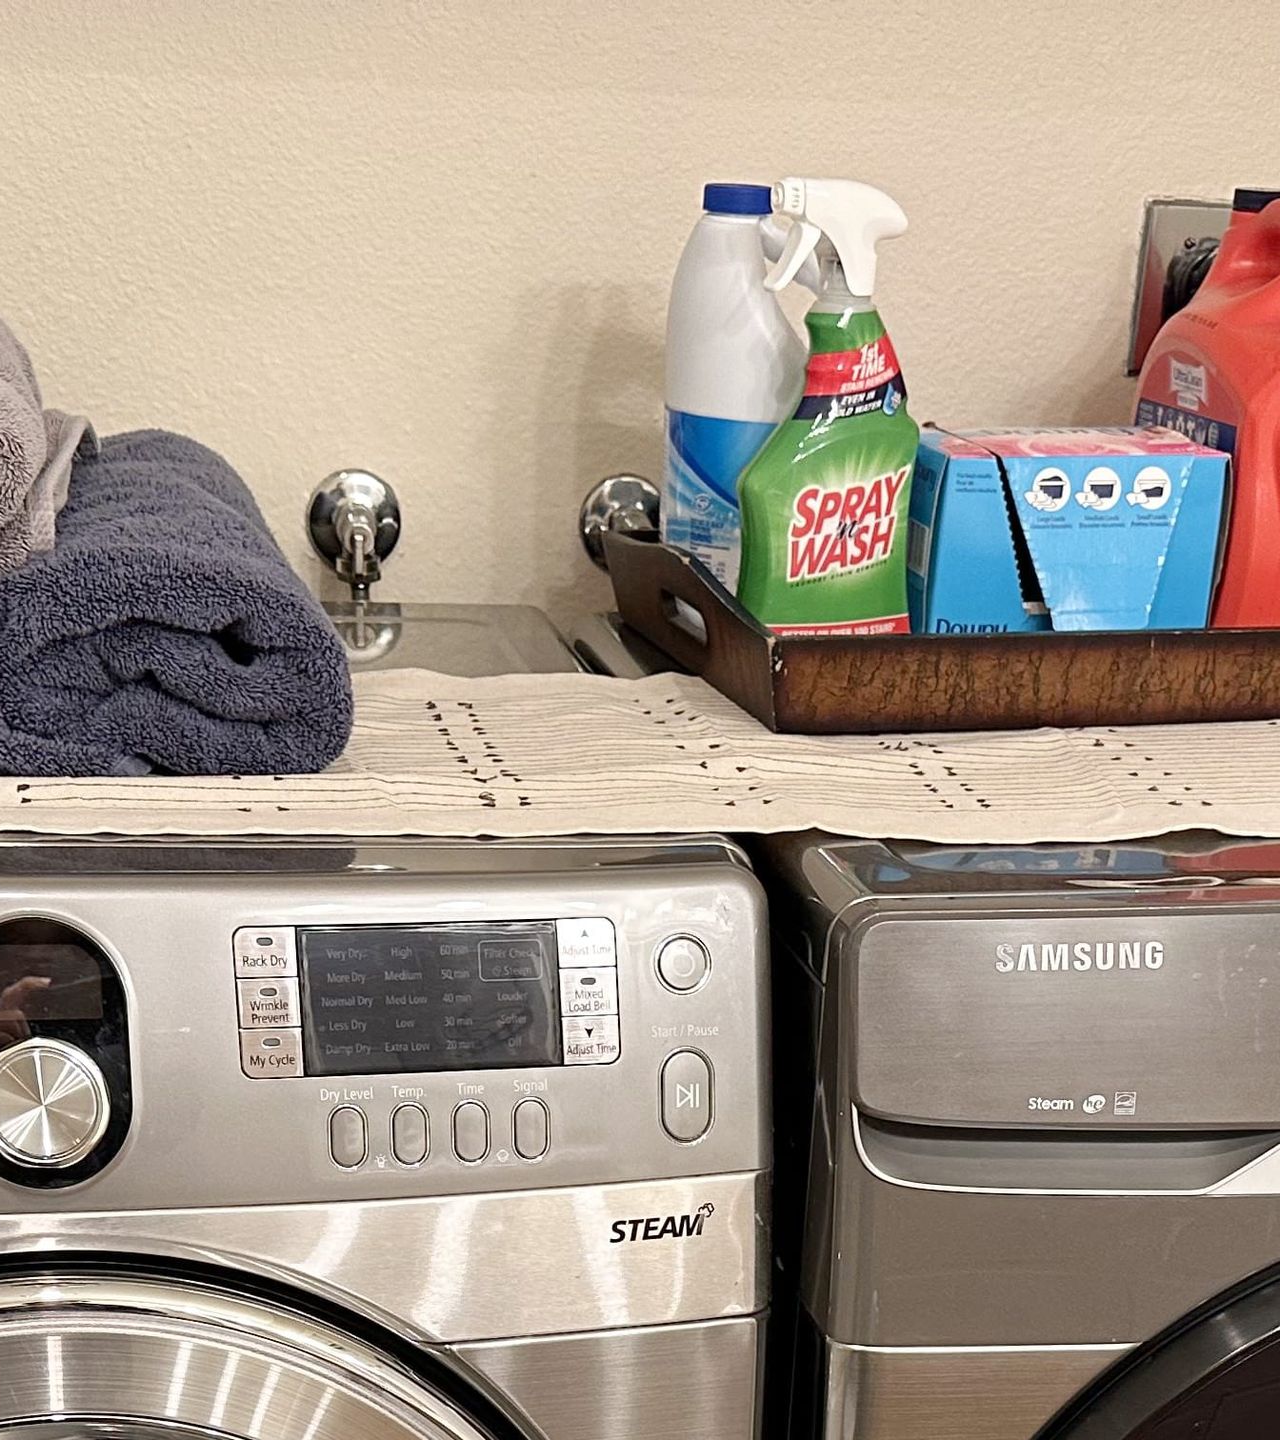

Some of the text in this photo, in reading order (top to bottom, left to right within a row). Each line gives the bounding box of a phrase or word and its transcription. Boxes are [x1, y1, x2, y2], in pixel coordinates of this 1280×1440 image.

[861, 342, 879, 363] 1st
[852, 354, 885, 381] TIME
[791, 468, 909, 539] SPRAY
[789, 515, 895, 580] WASH
[326, 948, 363, 961] Very Dry
[391, 946, 413, 959] High
[561, 945, 612, 957] Adjust Time
[995, 941, 1163, 972] SAMSUNG
[242, 955, 288, 969] Rack Dry
[327, 972, 366, 984] More Dry
[384, 970, 422, 981] Medium
[385, 995, 427, 1005] Med Low
[574, 989, 604, 1000] Mixed
[249, 1000, 289, 1011] Wrinkle
[321, 996, 373, 1008] Normal Dry
[568, 1001, 592, 1012] Load
[251, 1012, 289, 1024] Prevent
[395, 1019, 415, 1029] Low
[443, 1016, 456, 1027] 30
[329, 1020, 367, 1032] Less Dry
[651, 1025, 678, 1038] Start
[686, 1024, 719, 1037] Pause
[326, 1043, 371, 1056] Damp Dry
[384, 1041, 430, 1053] Extra Low
[566, 1043, 617, 1058] Adjust Time
[249, 1054, 296, 1068] My Cycle
[391, 1085, 427, 1100] Temp.
[456, 1082, 485, 1096] Time
[513, 1079, 548, 1093] Signal
[320, 1087, 374, 1103] Dry Level
[1028, 1097, 1073, 1110] Steam
[609, 1209, 705, 1243] STEAM
